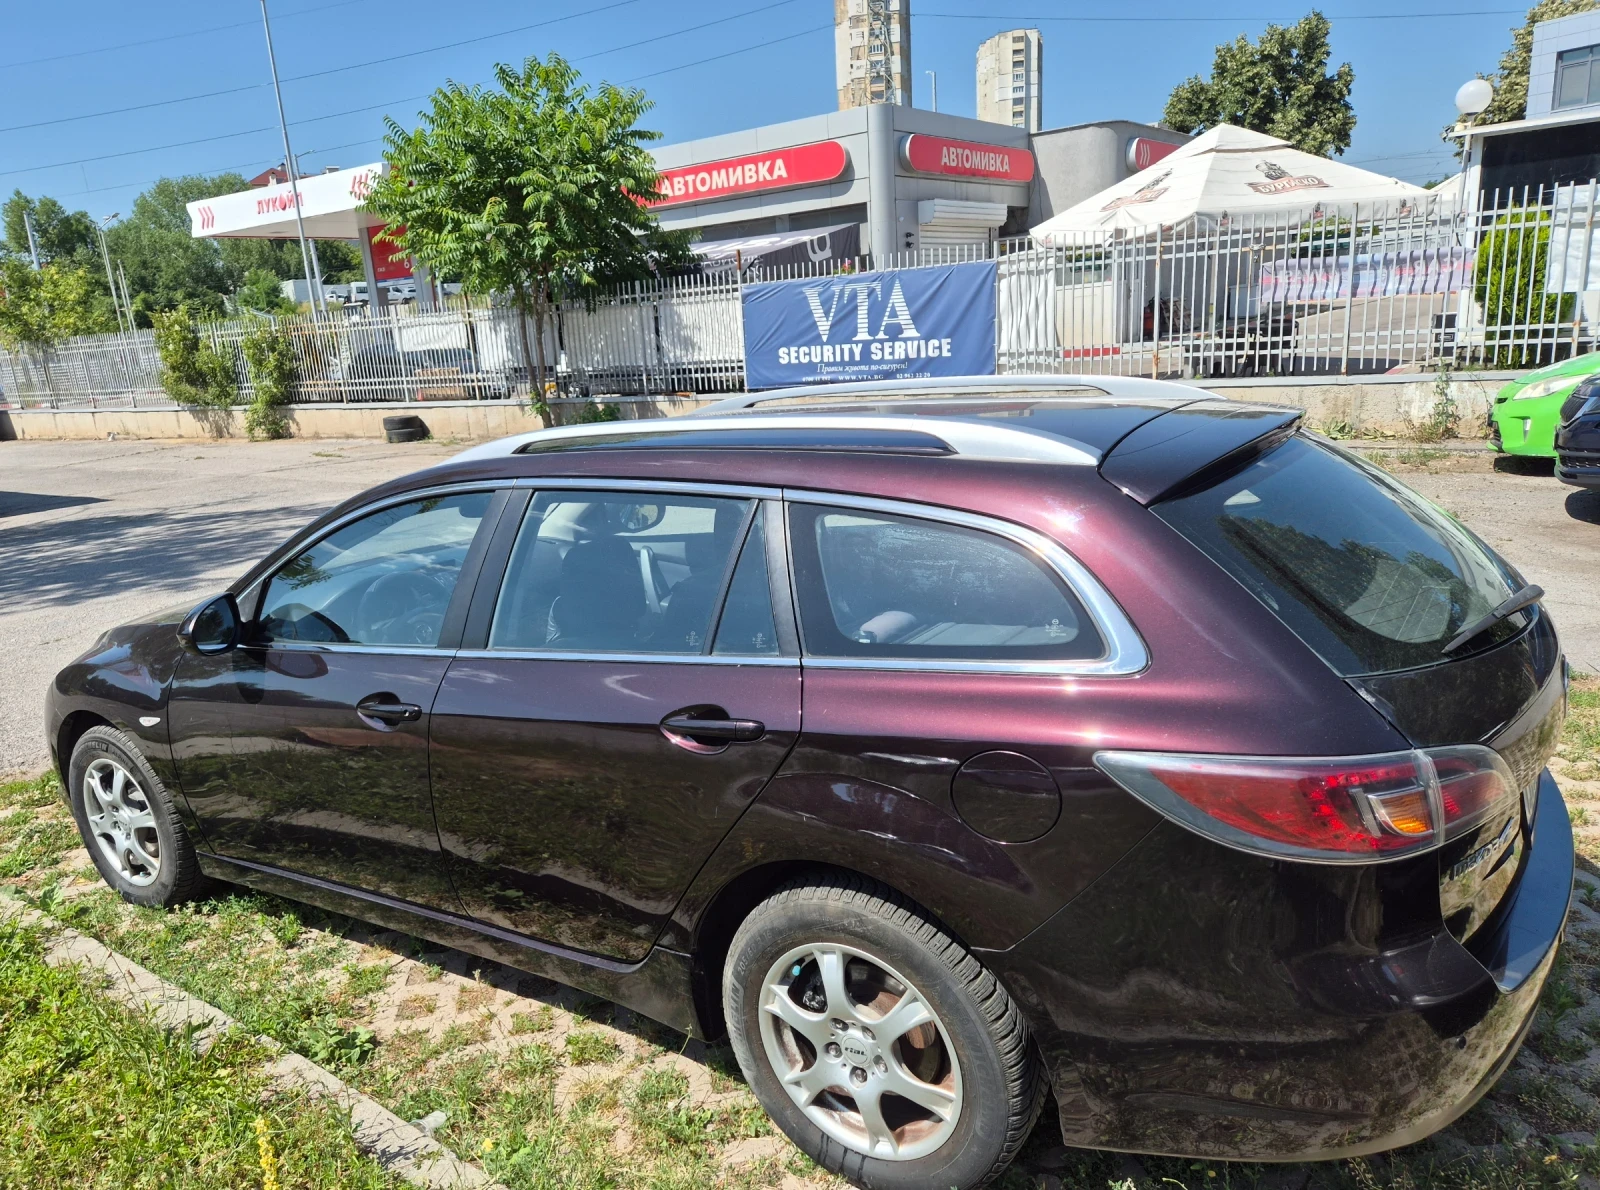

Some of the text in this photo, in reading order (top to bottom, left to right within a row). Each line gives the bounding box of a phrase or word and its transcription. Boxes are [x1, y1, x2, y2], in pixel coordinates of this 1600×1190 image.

[941, 145, 1010, 173] АВТОМИВКА
[660, 158, 788, 197] АВТОМИВКА
[1259, 177, 1319, 194] БУРГАСКО
[802, 278, 921, 342] VTA
[778, 338, 952, 365] SECURITY SERVICE
